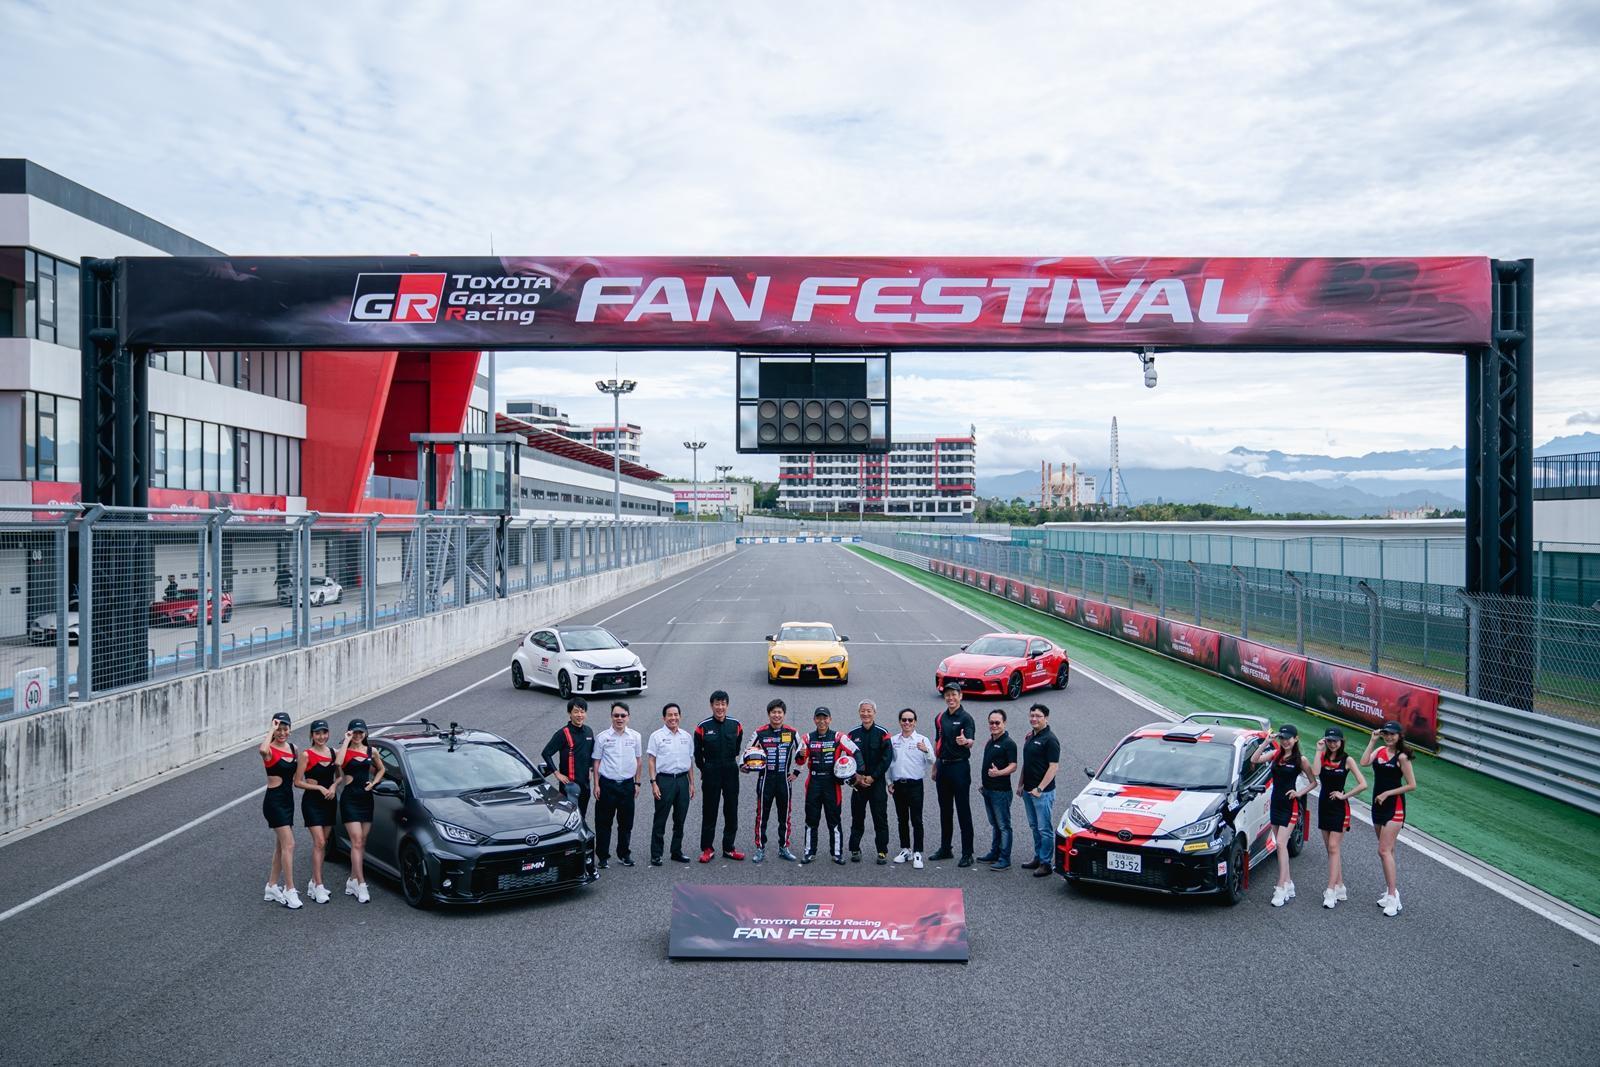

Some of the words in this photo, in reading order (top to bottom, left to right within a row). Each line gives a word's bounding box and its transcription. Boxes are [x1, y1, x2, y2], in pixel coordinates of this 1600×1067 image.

[452, 274, 551, 289] TOYOTA
[448, 291, 540, 305] GAZOO
[575, 276, 771, 322] FAN
[792, 276, 1249, 324] FESTIVAL
[353, 293, 437, 320] GR
[444, 307, 535, 326] Racing
[28, 690, 39, 704] 40
[1337, 696, 1350, 708] FAN
[1351, 701, 1384, 719] FESTIVAL
[1114, 859, 1139, 871] 39-52
[805, 909, 832, 918] GR
[800, 918, 841, 926] GAZOO
[843, 918, 881, 928] Racing
[733, 927, 783, 939] FAN
[787, 928, 905, 940] FESTIVAL
